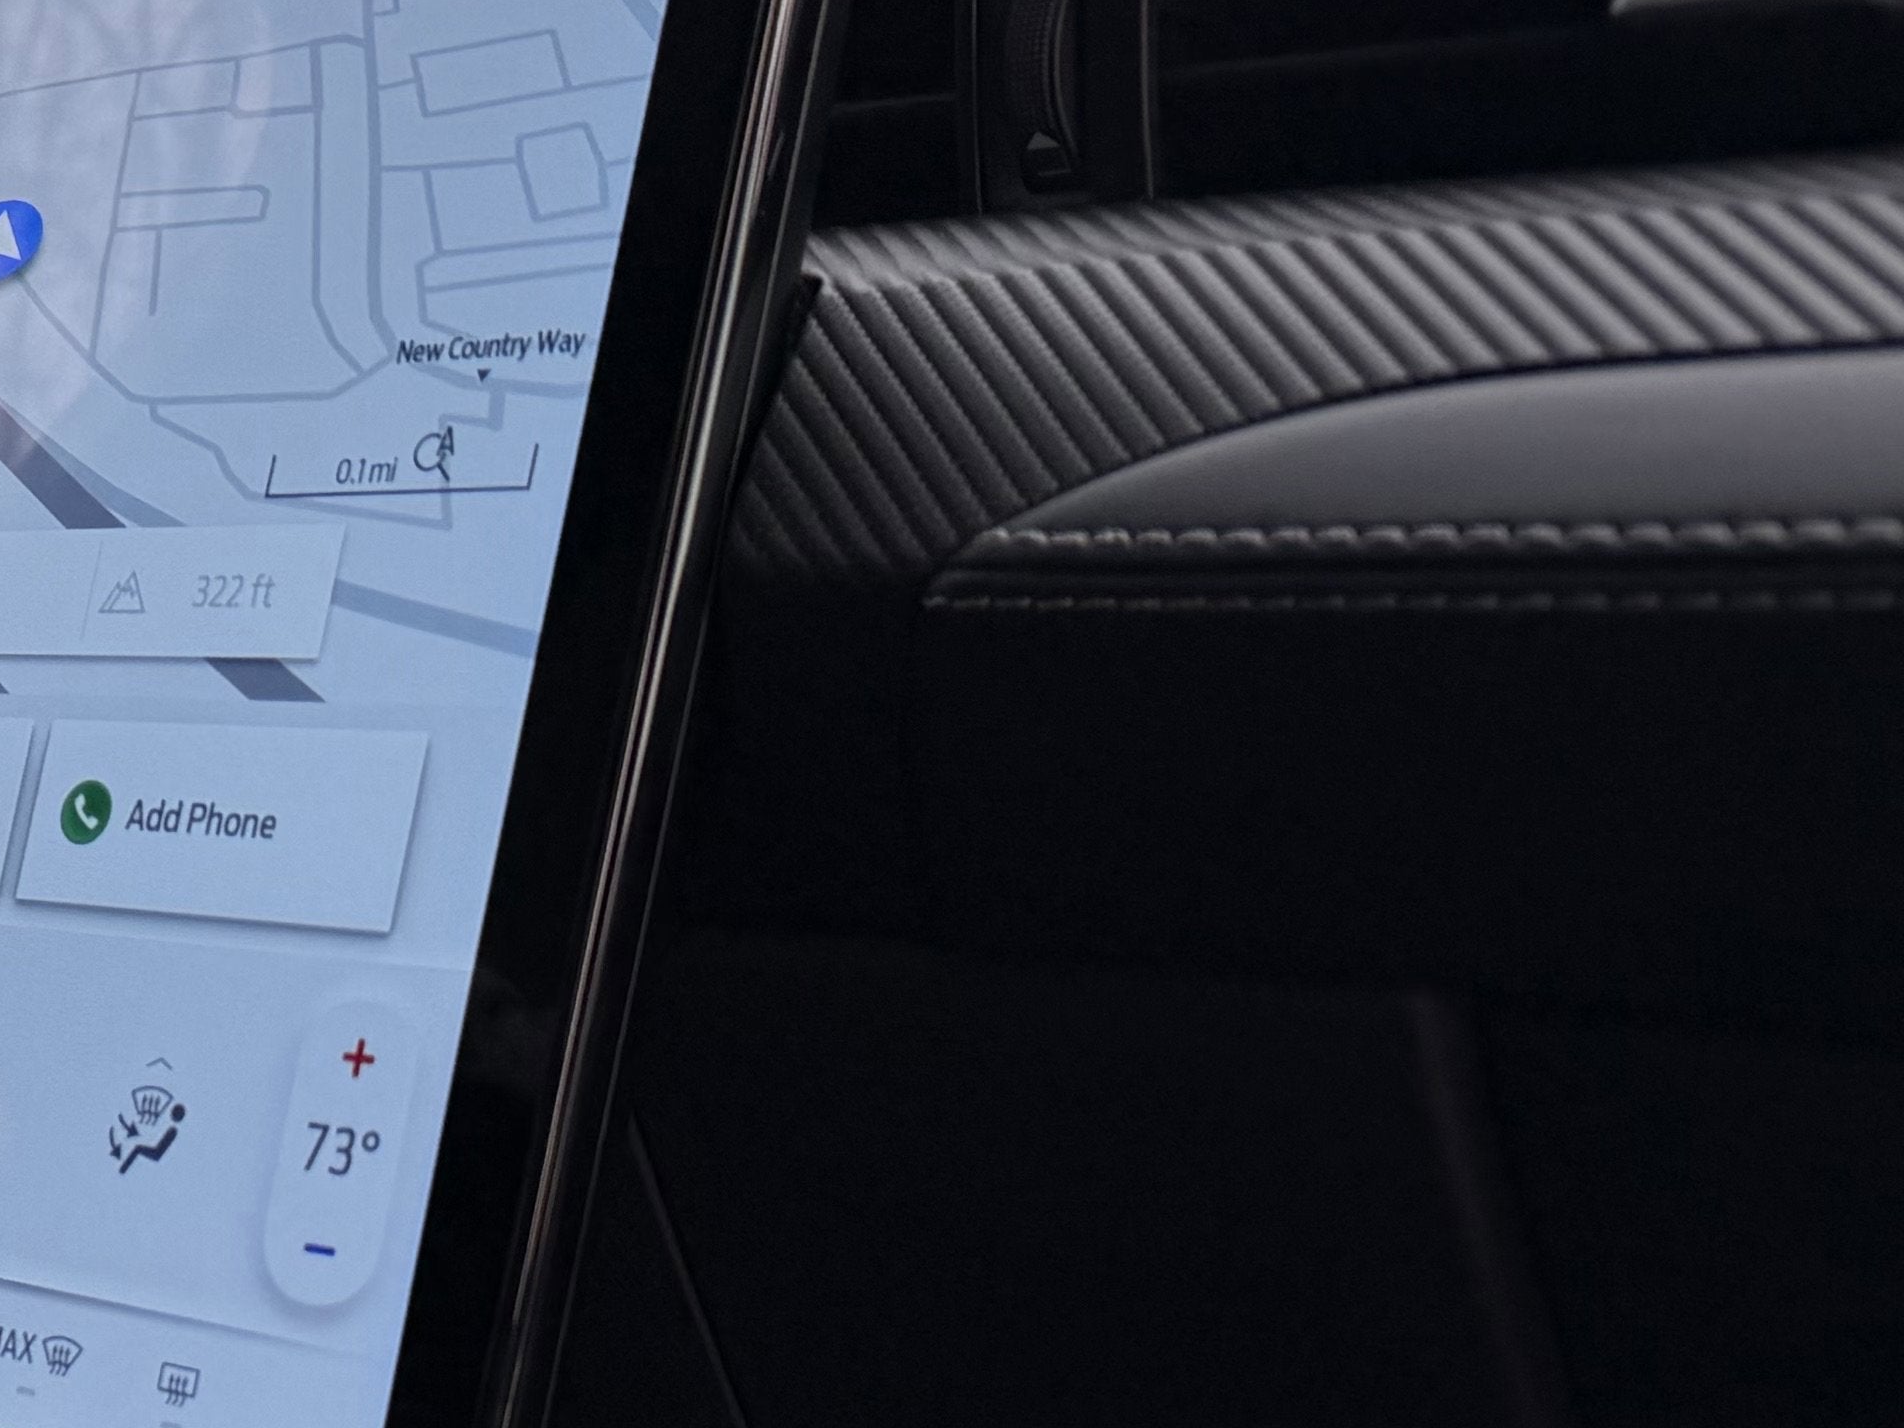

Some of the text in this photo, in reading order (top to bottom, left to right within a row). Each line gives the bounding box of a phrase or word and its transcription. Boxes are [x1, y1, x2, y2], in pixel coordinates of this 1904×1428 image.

[396, 329, 586, 365] New Country Way
[192, 573, 276, 608] 322 ft
[124, 798, 277, 840] Add Phone
[304, 1121, 381, 1176] 73°
